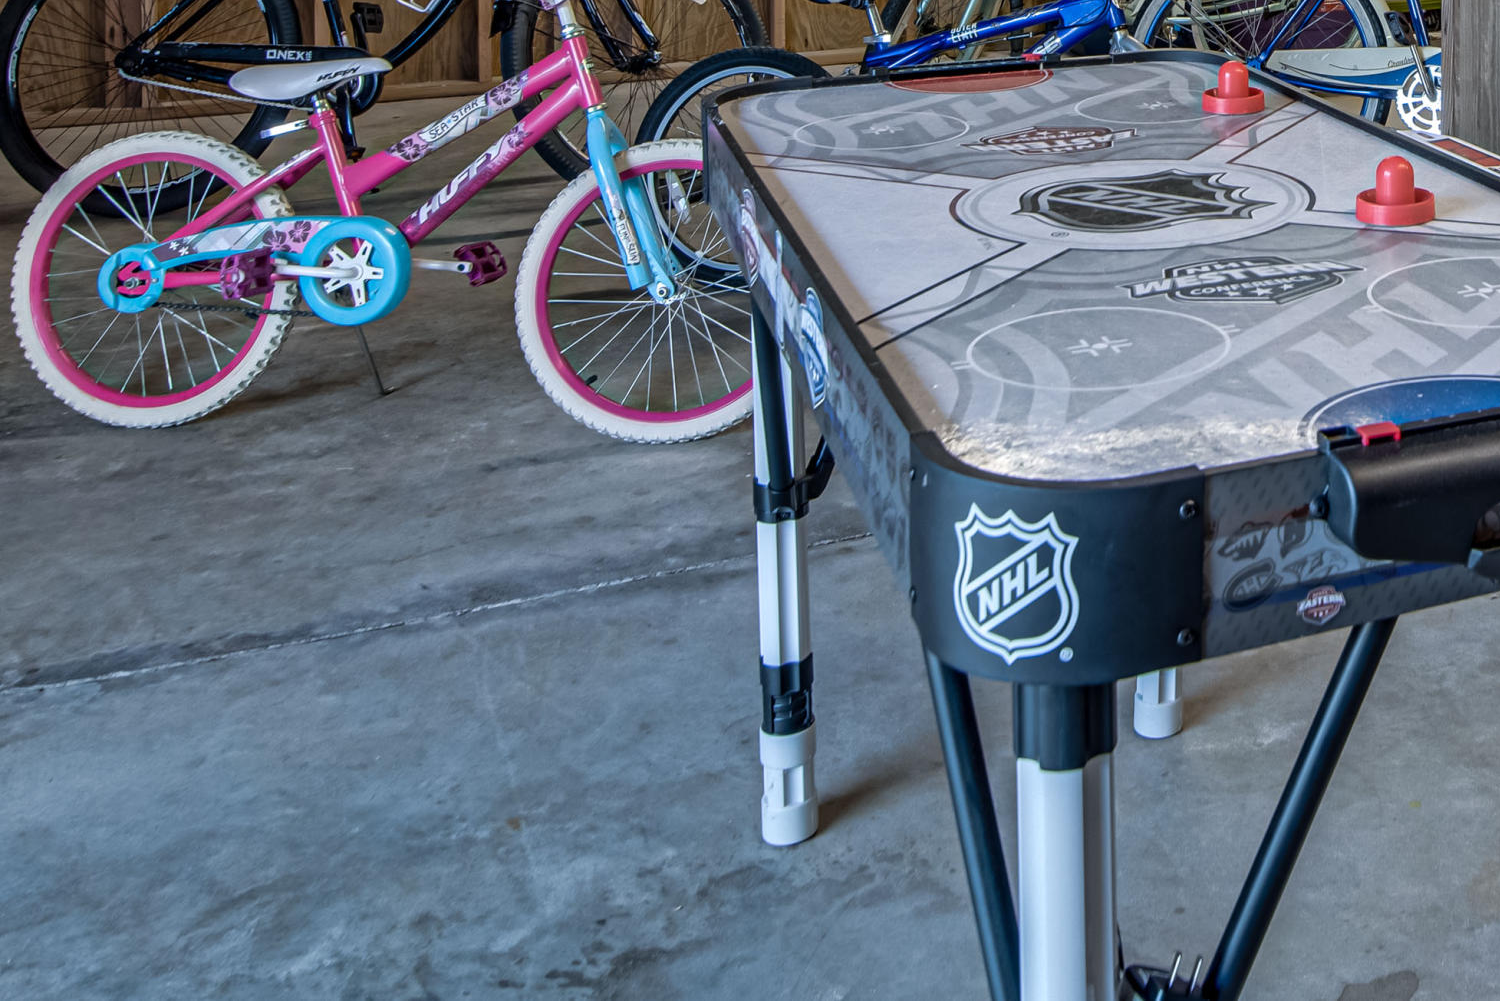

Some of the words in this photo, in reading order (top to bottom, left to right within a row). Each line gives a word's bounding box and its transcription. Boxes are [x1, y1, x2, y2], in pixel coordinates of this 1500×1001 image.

[428, 120, 450, 140] SEA
[451, 99, 480, 122] STAR
[418, 134, 508, 225] HUFFY
[1058, 188, 1198, 214] NHL
[1134, 261, 1352, 297] WESTERN
[1186, 260, 1270, 276] NHL
[1189, 274, 1315, 296] CONFERENCE
[978, 552, 1050, 623] NHL
[1298, 591, 1345, 612] EASTERN
